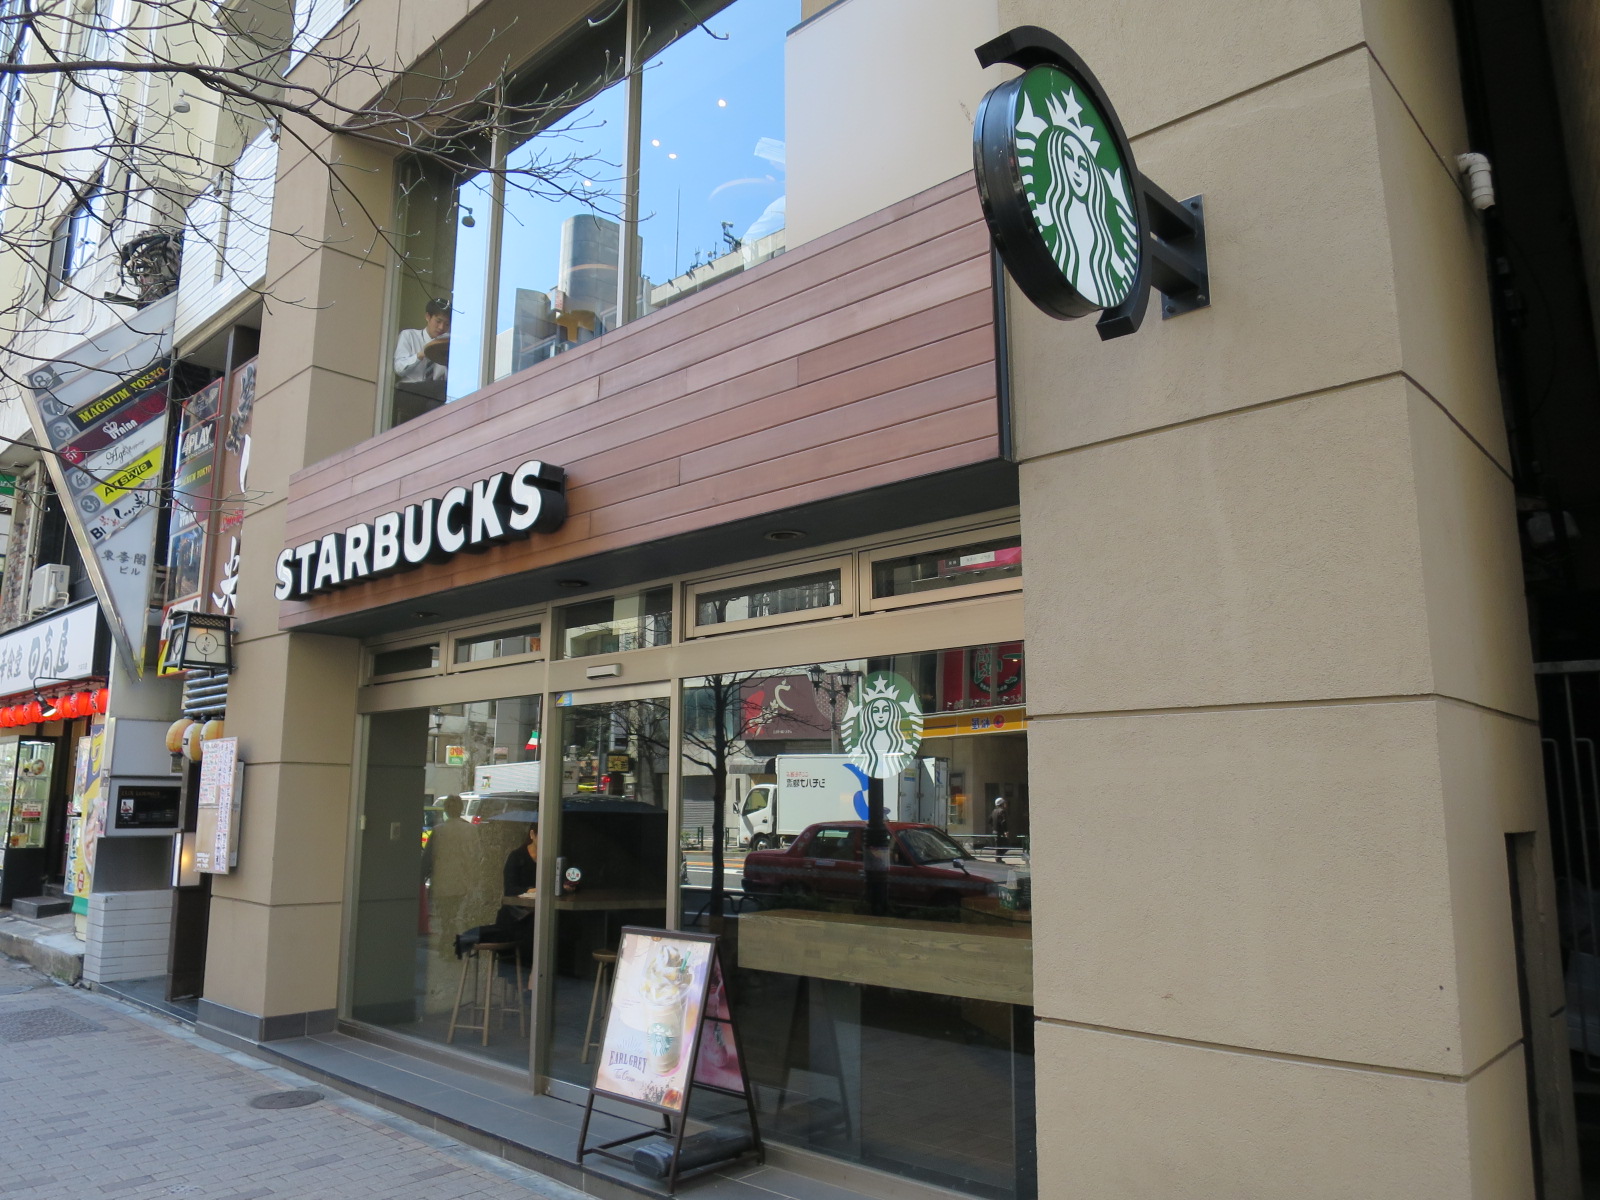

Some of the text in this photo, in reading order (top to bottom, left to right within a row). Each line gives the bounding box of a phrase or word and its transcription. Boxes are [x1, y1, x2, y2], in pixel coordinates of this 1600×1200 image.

[77, 388, 131, 423] MAGNUM
[274, 460, 542, 600] STARBUCKS
[119, 566, 141, 576] ビル
[28, 617, 69, 680] 日高屋
[608, 1051, 647, 1074] EARL GREY
